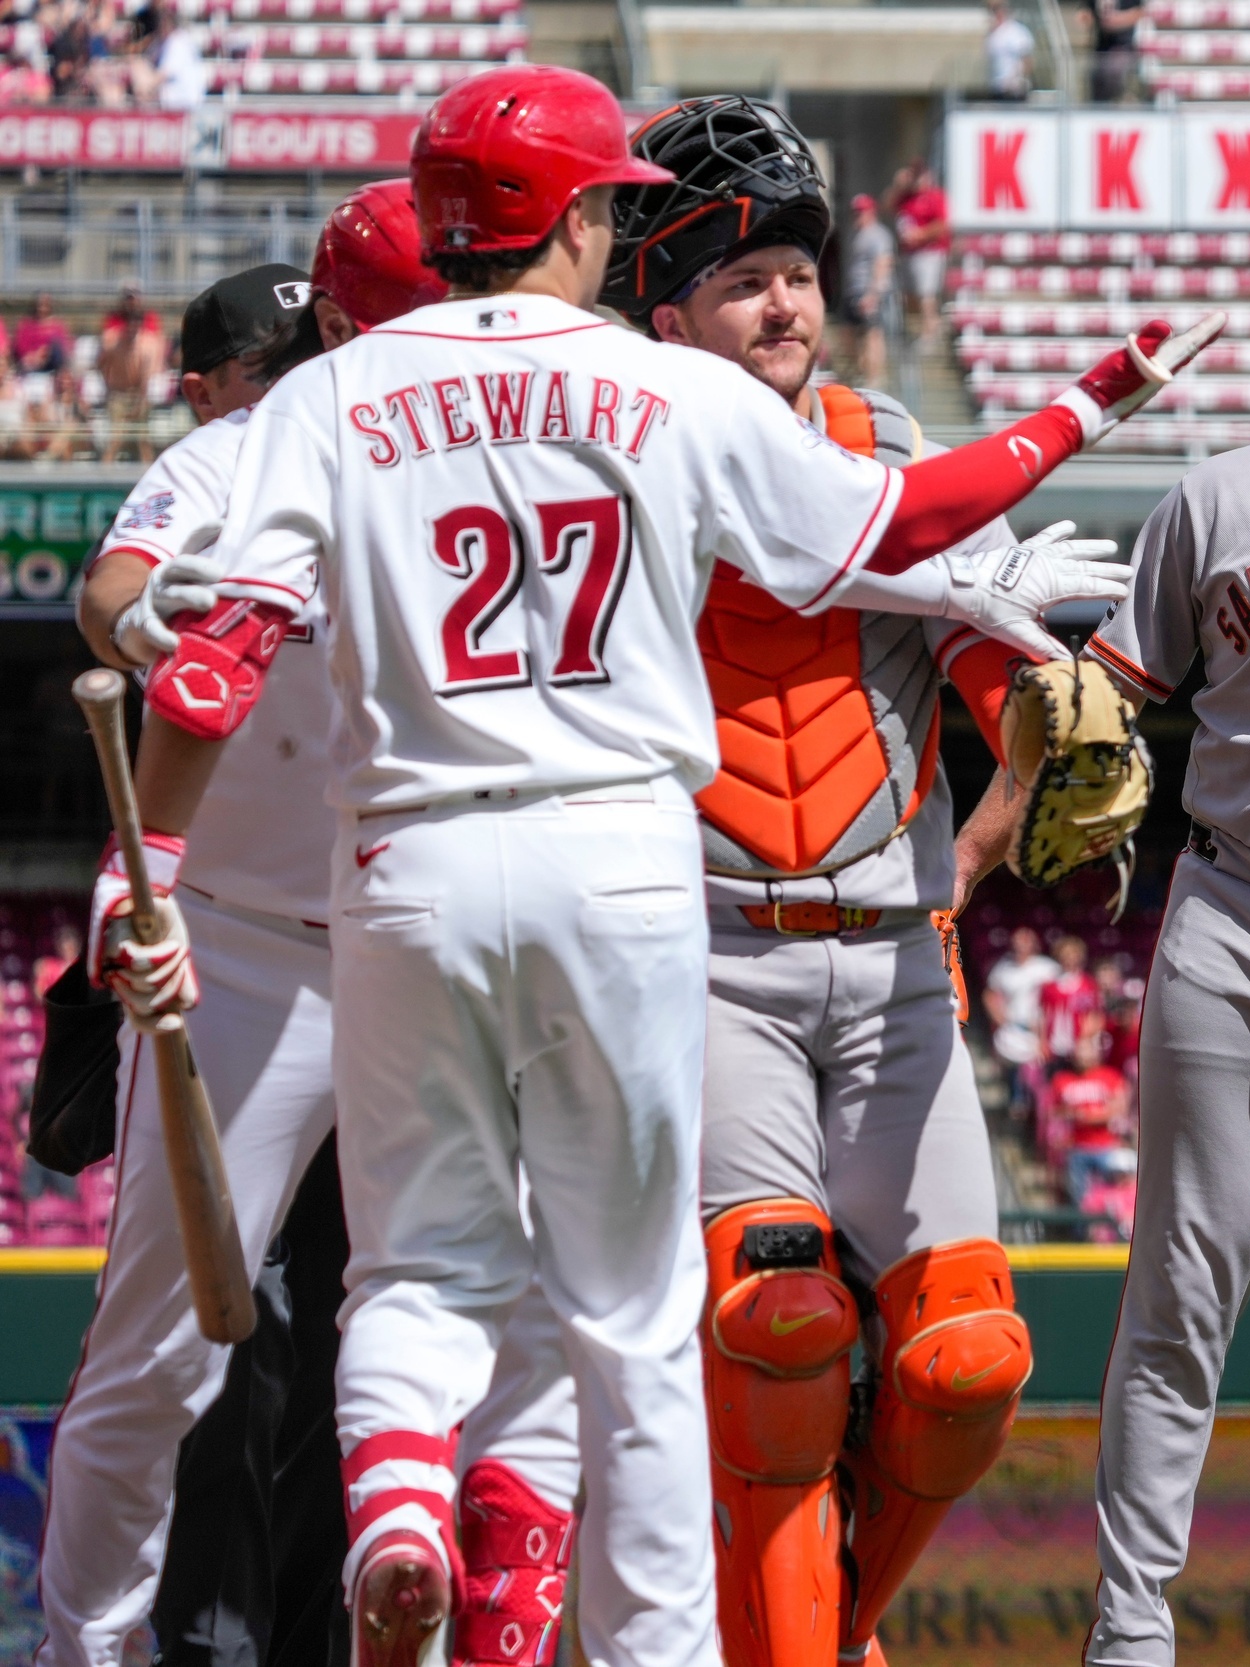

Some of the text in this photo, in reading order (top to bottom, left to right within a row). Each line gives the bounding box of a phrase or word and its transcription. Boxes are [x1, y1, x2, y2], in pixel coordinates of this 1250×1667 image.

[978, 130, 1028, 211] K
[1096, 130, 1142, 211] K
[347, 369, 671, 468] STEWART
[424, 491, 633, 699] 27
